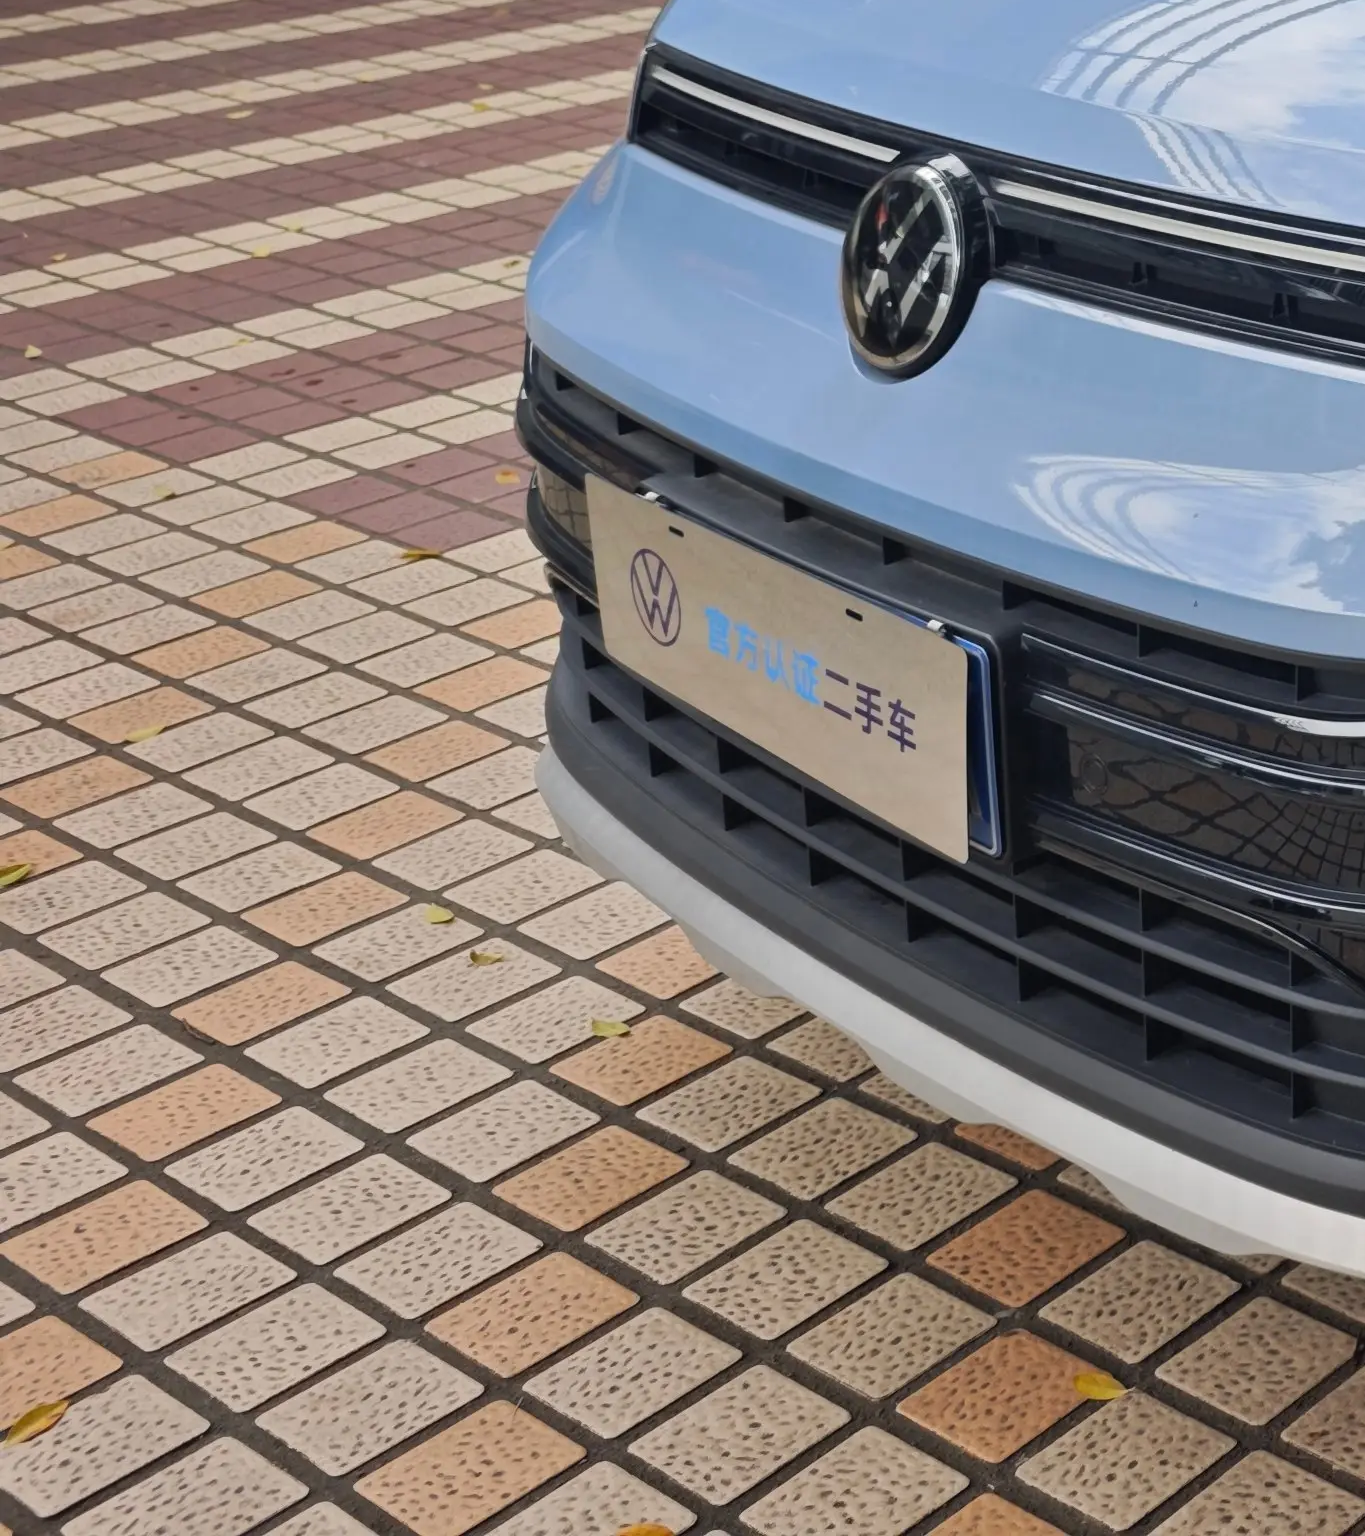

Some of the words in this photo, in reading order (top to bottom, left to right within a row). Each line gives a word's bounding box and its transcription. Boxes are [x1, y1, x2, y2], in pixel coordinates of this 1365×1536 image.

[704, 605, 917, 754] 官方认证二手车
